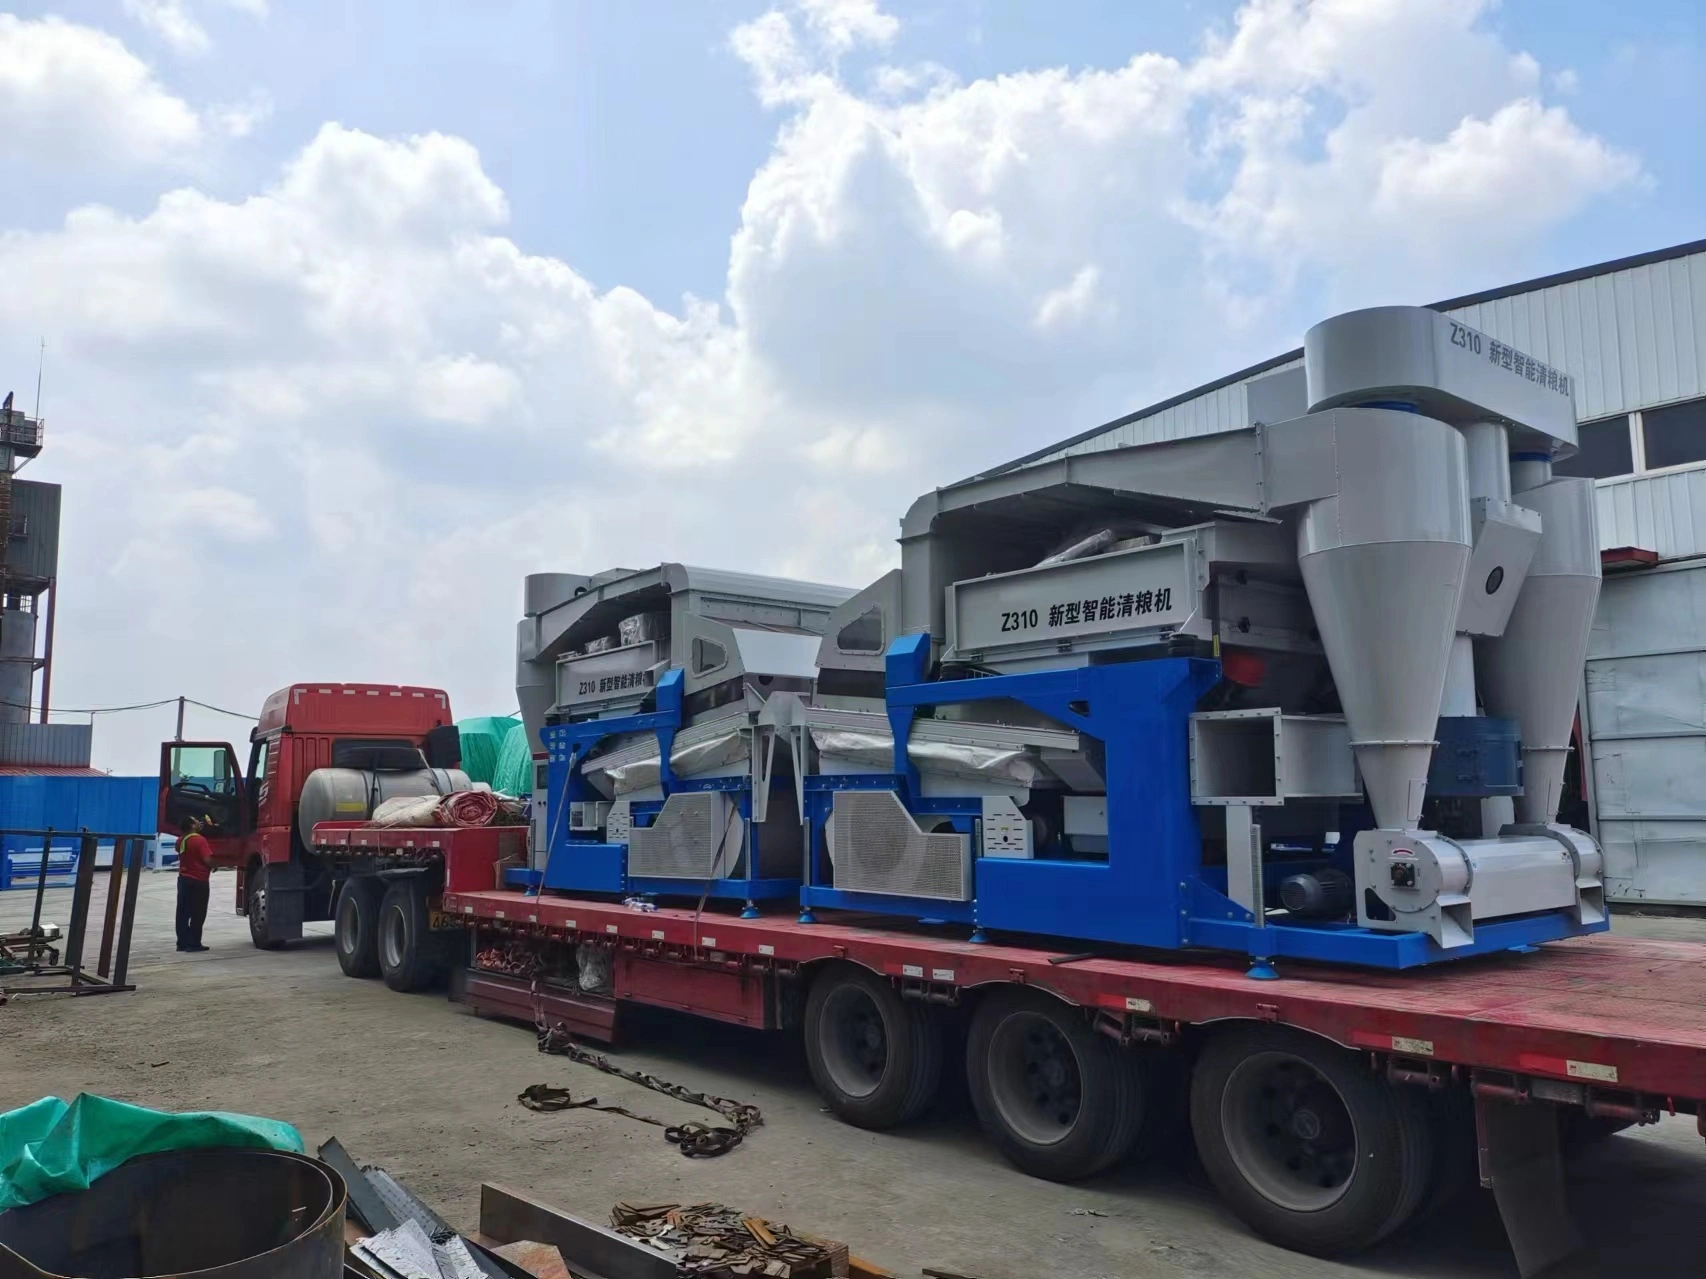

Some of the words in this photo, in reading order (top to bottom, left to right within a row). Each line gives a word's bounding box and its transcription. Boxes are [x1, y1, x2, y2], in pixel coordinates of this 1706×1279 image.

[1450, 322, 1481, 355] Z310
[1489, 340, 1569, 397] 新型智能清粮机
[1001, 608, 1038, 632] Z310
[1048, 587, 1172, 627] 新型智能清粮机
[579, 680, 595, 695] Z310
